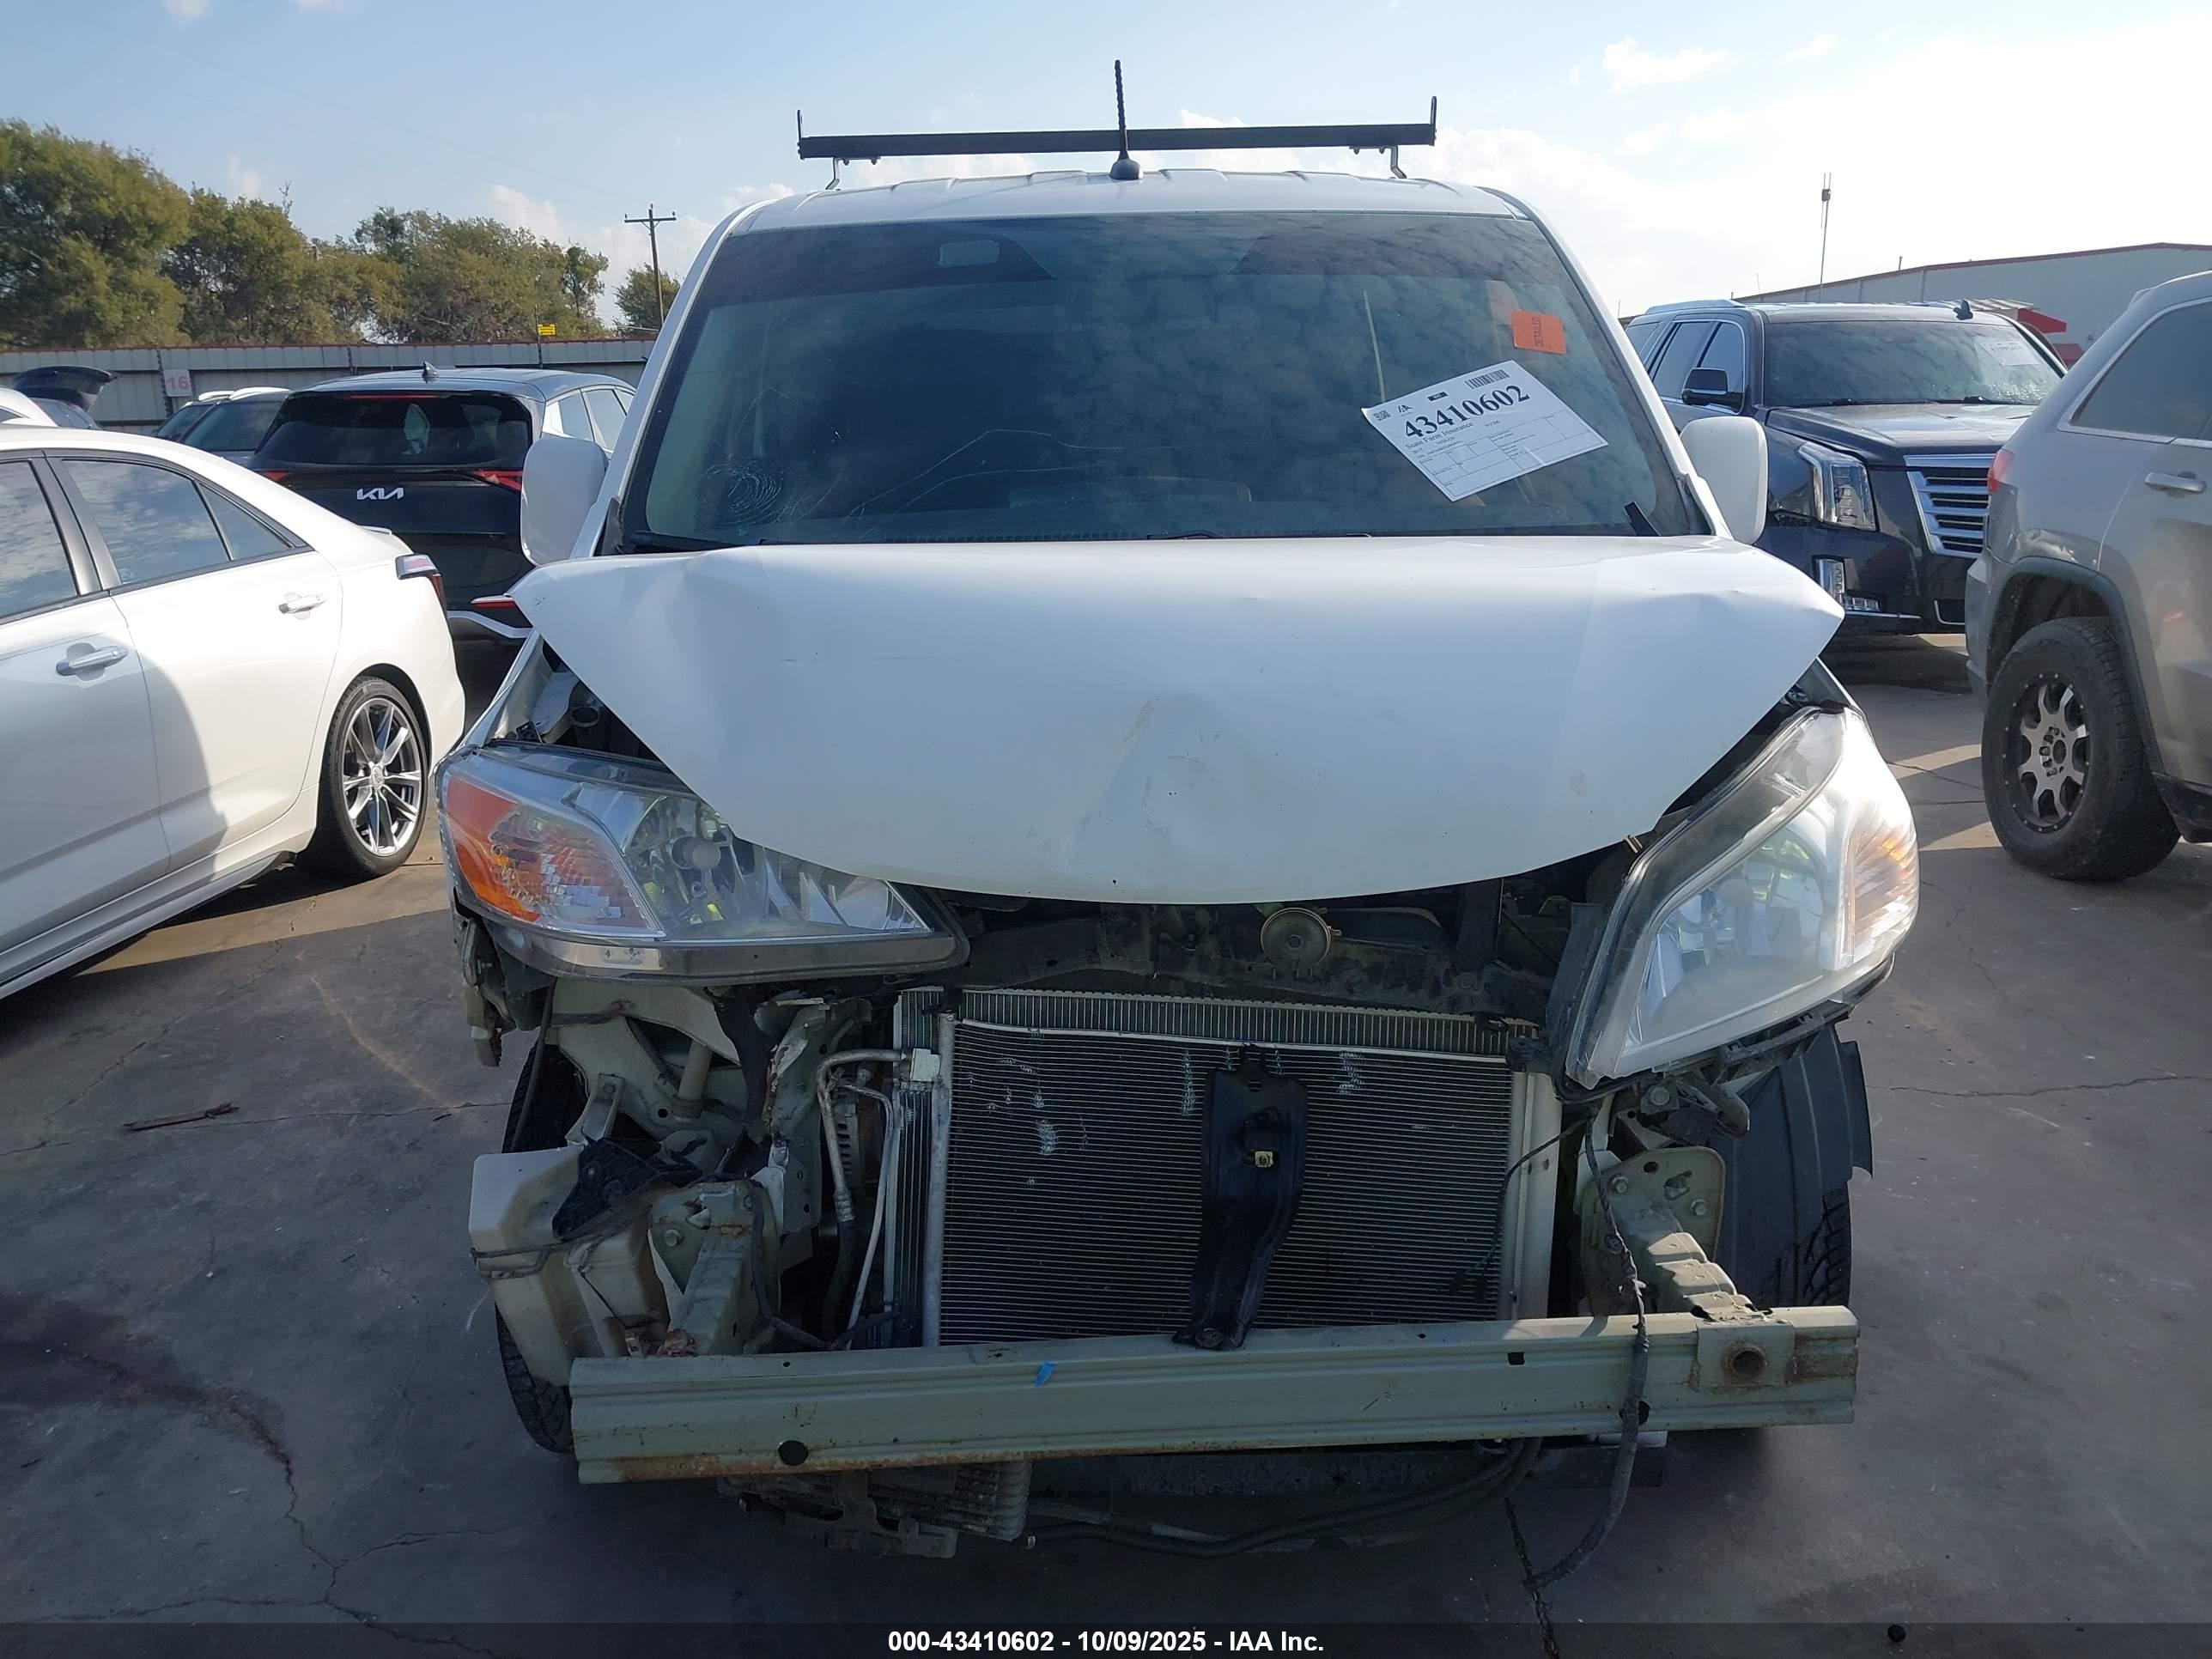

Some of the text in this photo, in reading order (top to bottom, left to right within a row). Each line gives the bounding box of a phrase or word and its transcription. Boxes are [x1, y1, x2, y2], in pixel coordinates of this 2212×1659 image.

[167, 376, 190, 390] 16
[1404, 385, 1530, 438] 43410602
[1405, 440, 1424, 449] State
[1423, 433, 1443, 443] Farm
[1442, 422, 1474, 436] Insurance
[356, 487, 404, 500] KIA
